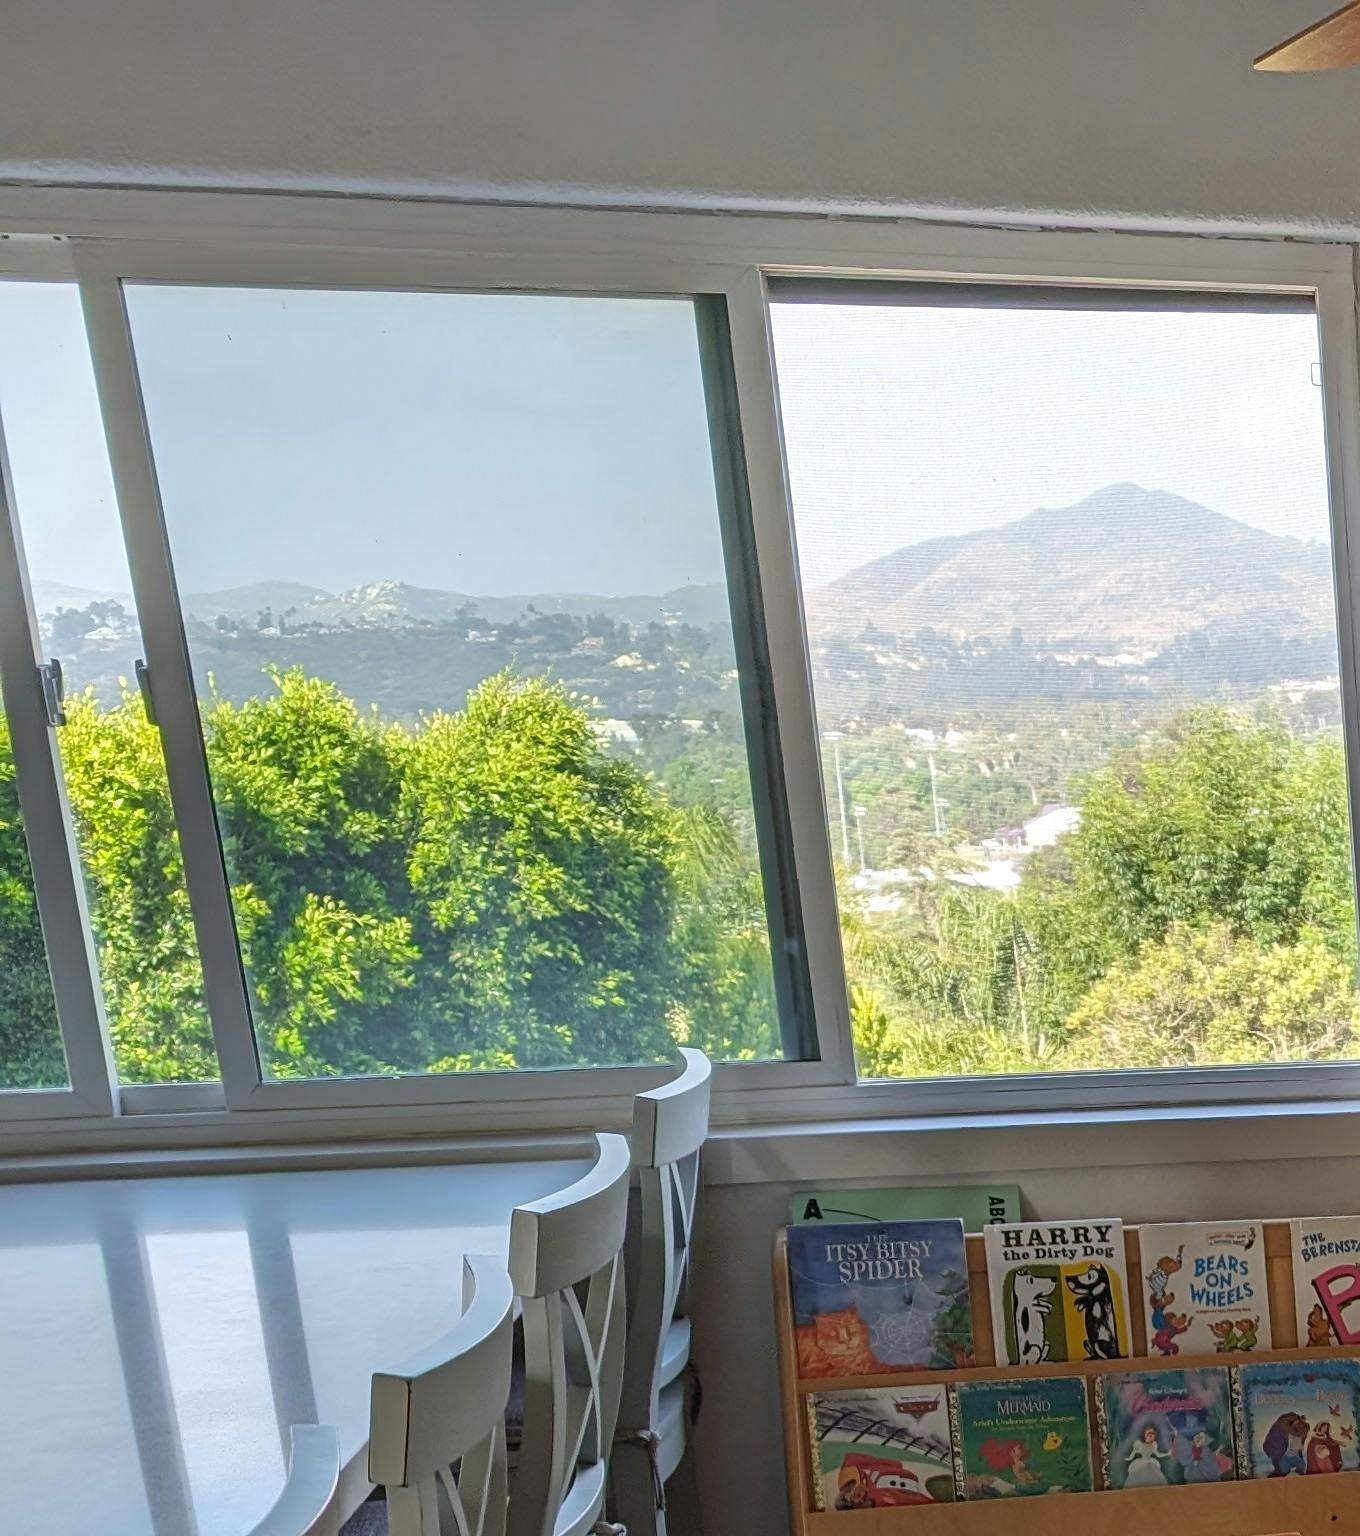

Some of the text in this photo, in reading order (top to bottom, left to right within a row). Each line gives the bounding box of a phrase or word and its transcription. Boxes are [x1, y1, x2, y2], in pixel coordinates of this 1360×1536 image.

[803, 1198, 822, 1220] A
[1002, 1224, 1112, 1248] HARRY
[1302, 1232, 1326, 1246] THE
[824, 1240, 932, 1262] ITSY BITSY
[1003, 1246, 1114, 1262] the Dirty Dog
[838, 1258, 924, 1282] SPIDER
[1194, 1254, 1248, 1278] BEARS
[1206, 1272, 1232, 1289] ON
[1190, 1282, 1254, 1306] WHEELS
[996, 1399, 1051, 1416] MERMAID
